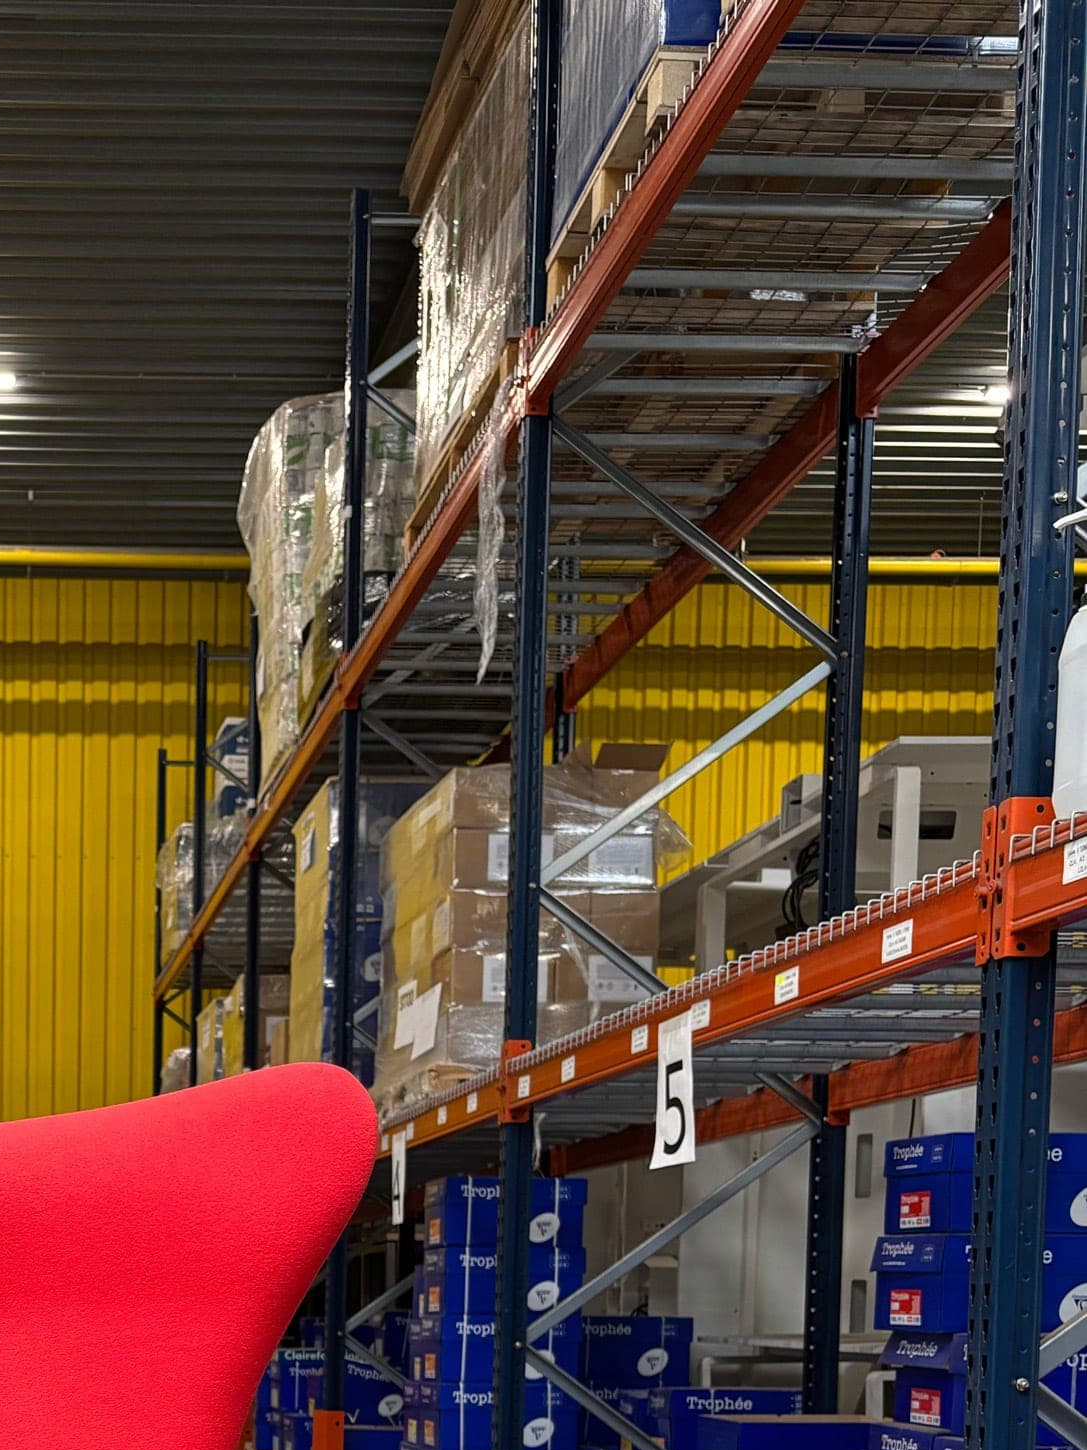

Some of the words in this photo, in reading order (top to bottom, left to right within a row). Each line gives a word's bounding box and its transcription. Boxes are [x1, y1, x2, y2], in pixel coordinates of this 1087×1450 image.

[663, 1058, 686, 1155] 5
[893, 1144, 924, 1161] Trophée
[392, 1159, 401, 1217] 4
[881, 1241, 914, 1257] Trophée
[583, 1323, 632, 1337] rophée
[896, 1340, 939, 1359] Trophée
[686, 1396, 753, 1412] Trophée
